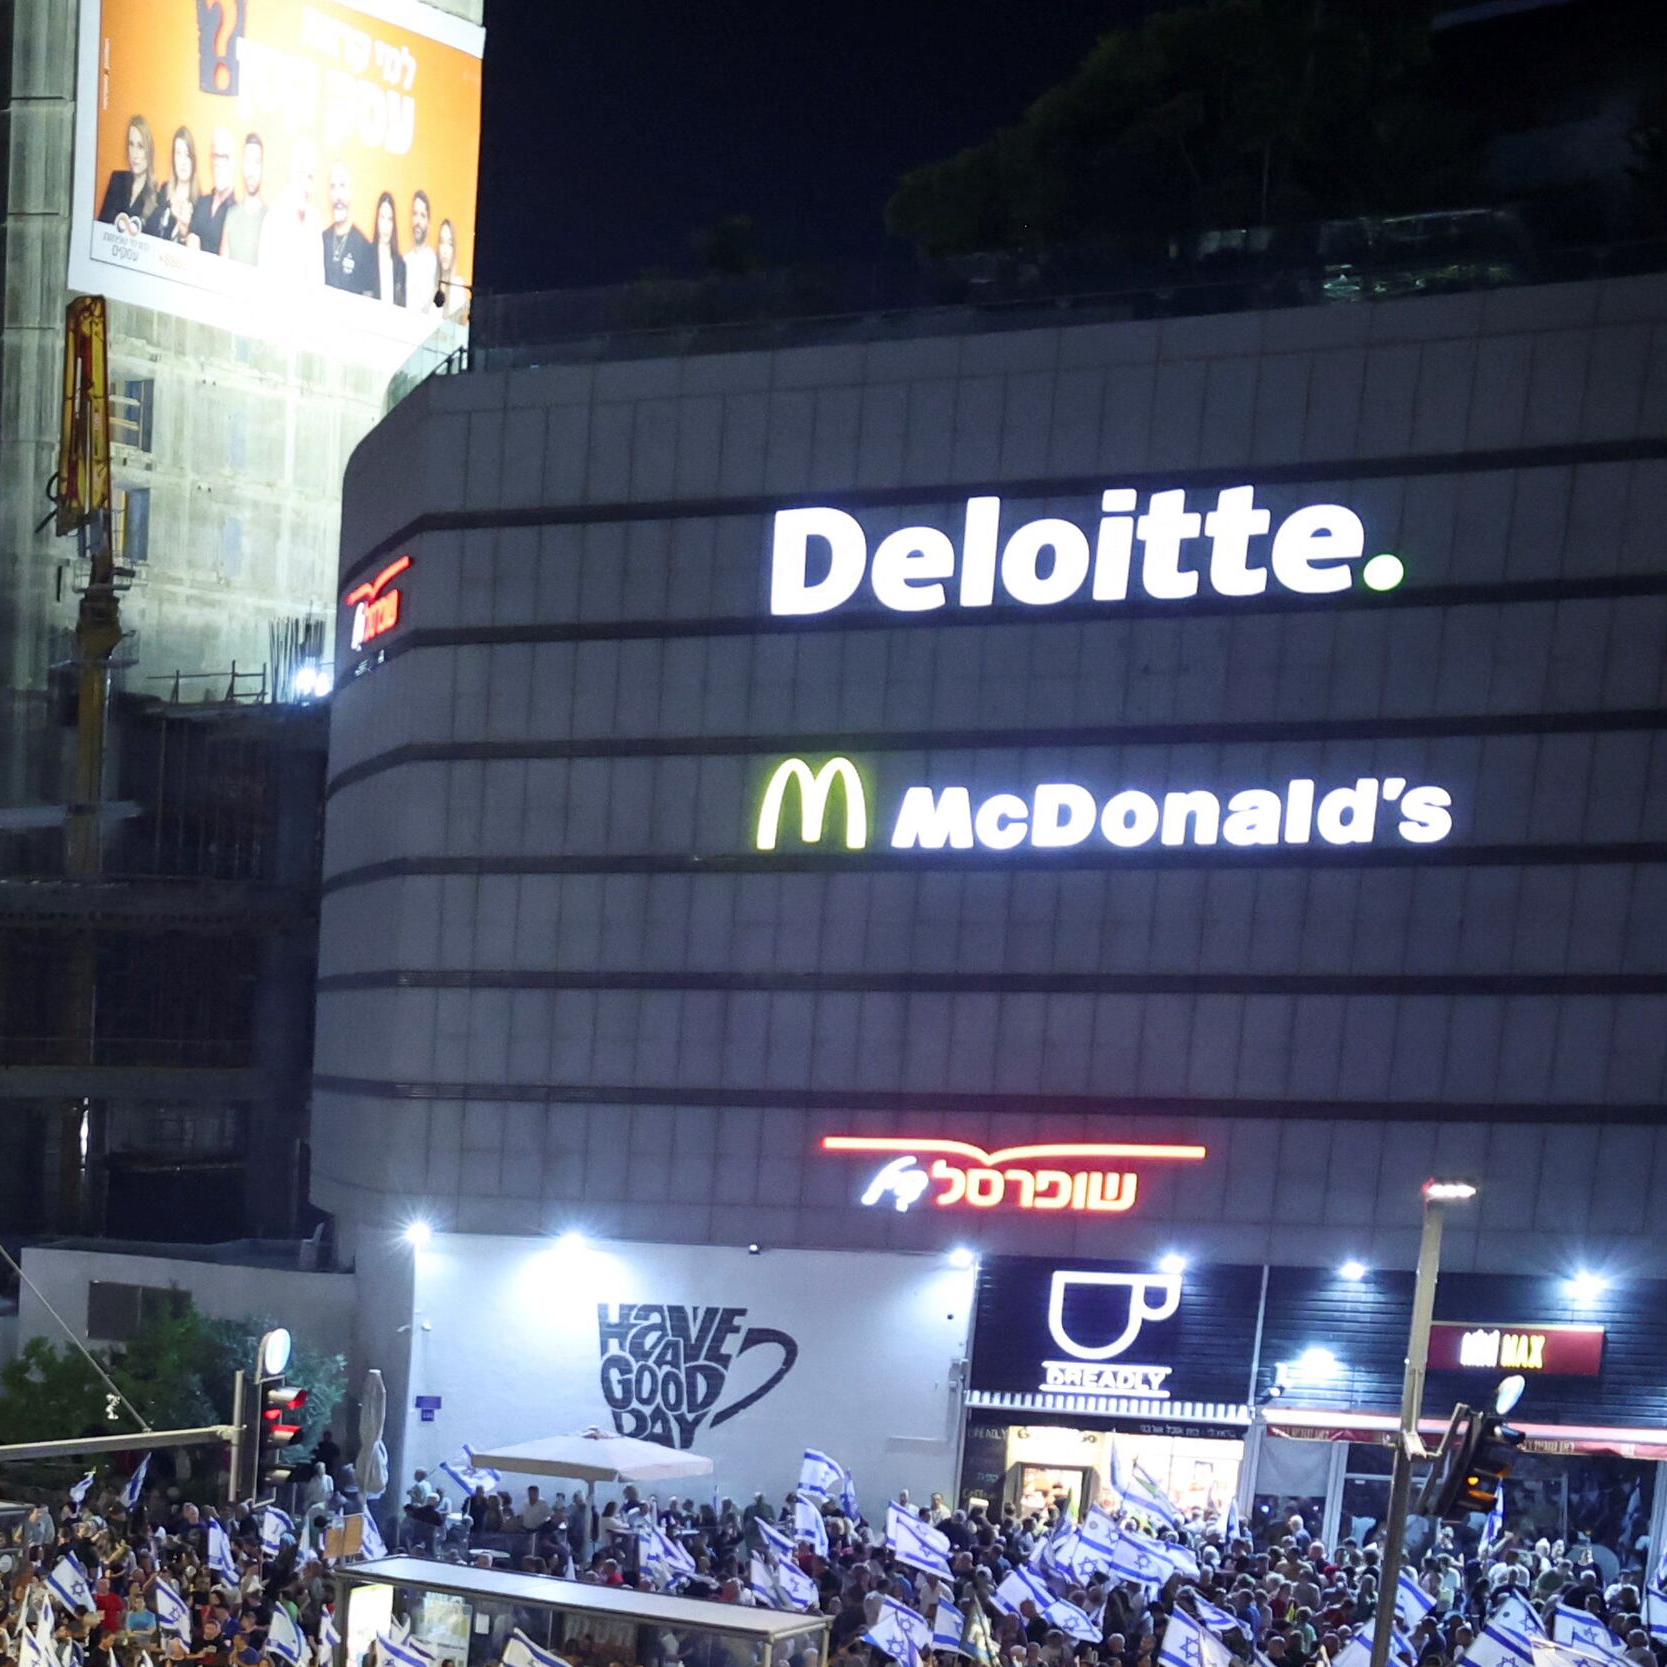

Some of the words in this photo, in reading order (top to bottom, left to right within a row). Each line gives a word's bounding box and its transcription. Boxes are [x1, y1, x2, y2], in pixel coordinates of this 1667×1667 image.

[770, 485, 1405, 616] Deloitte.
[890, 777, 1453, 851] McDonald's
[932, 1160, 1137, 1212] שופרסל
[1501, 1332, 1546, 1369] MAX
[600, 1354, 727, 1415] GOOD
[611, 1403, 712, 1450] DAY
